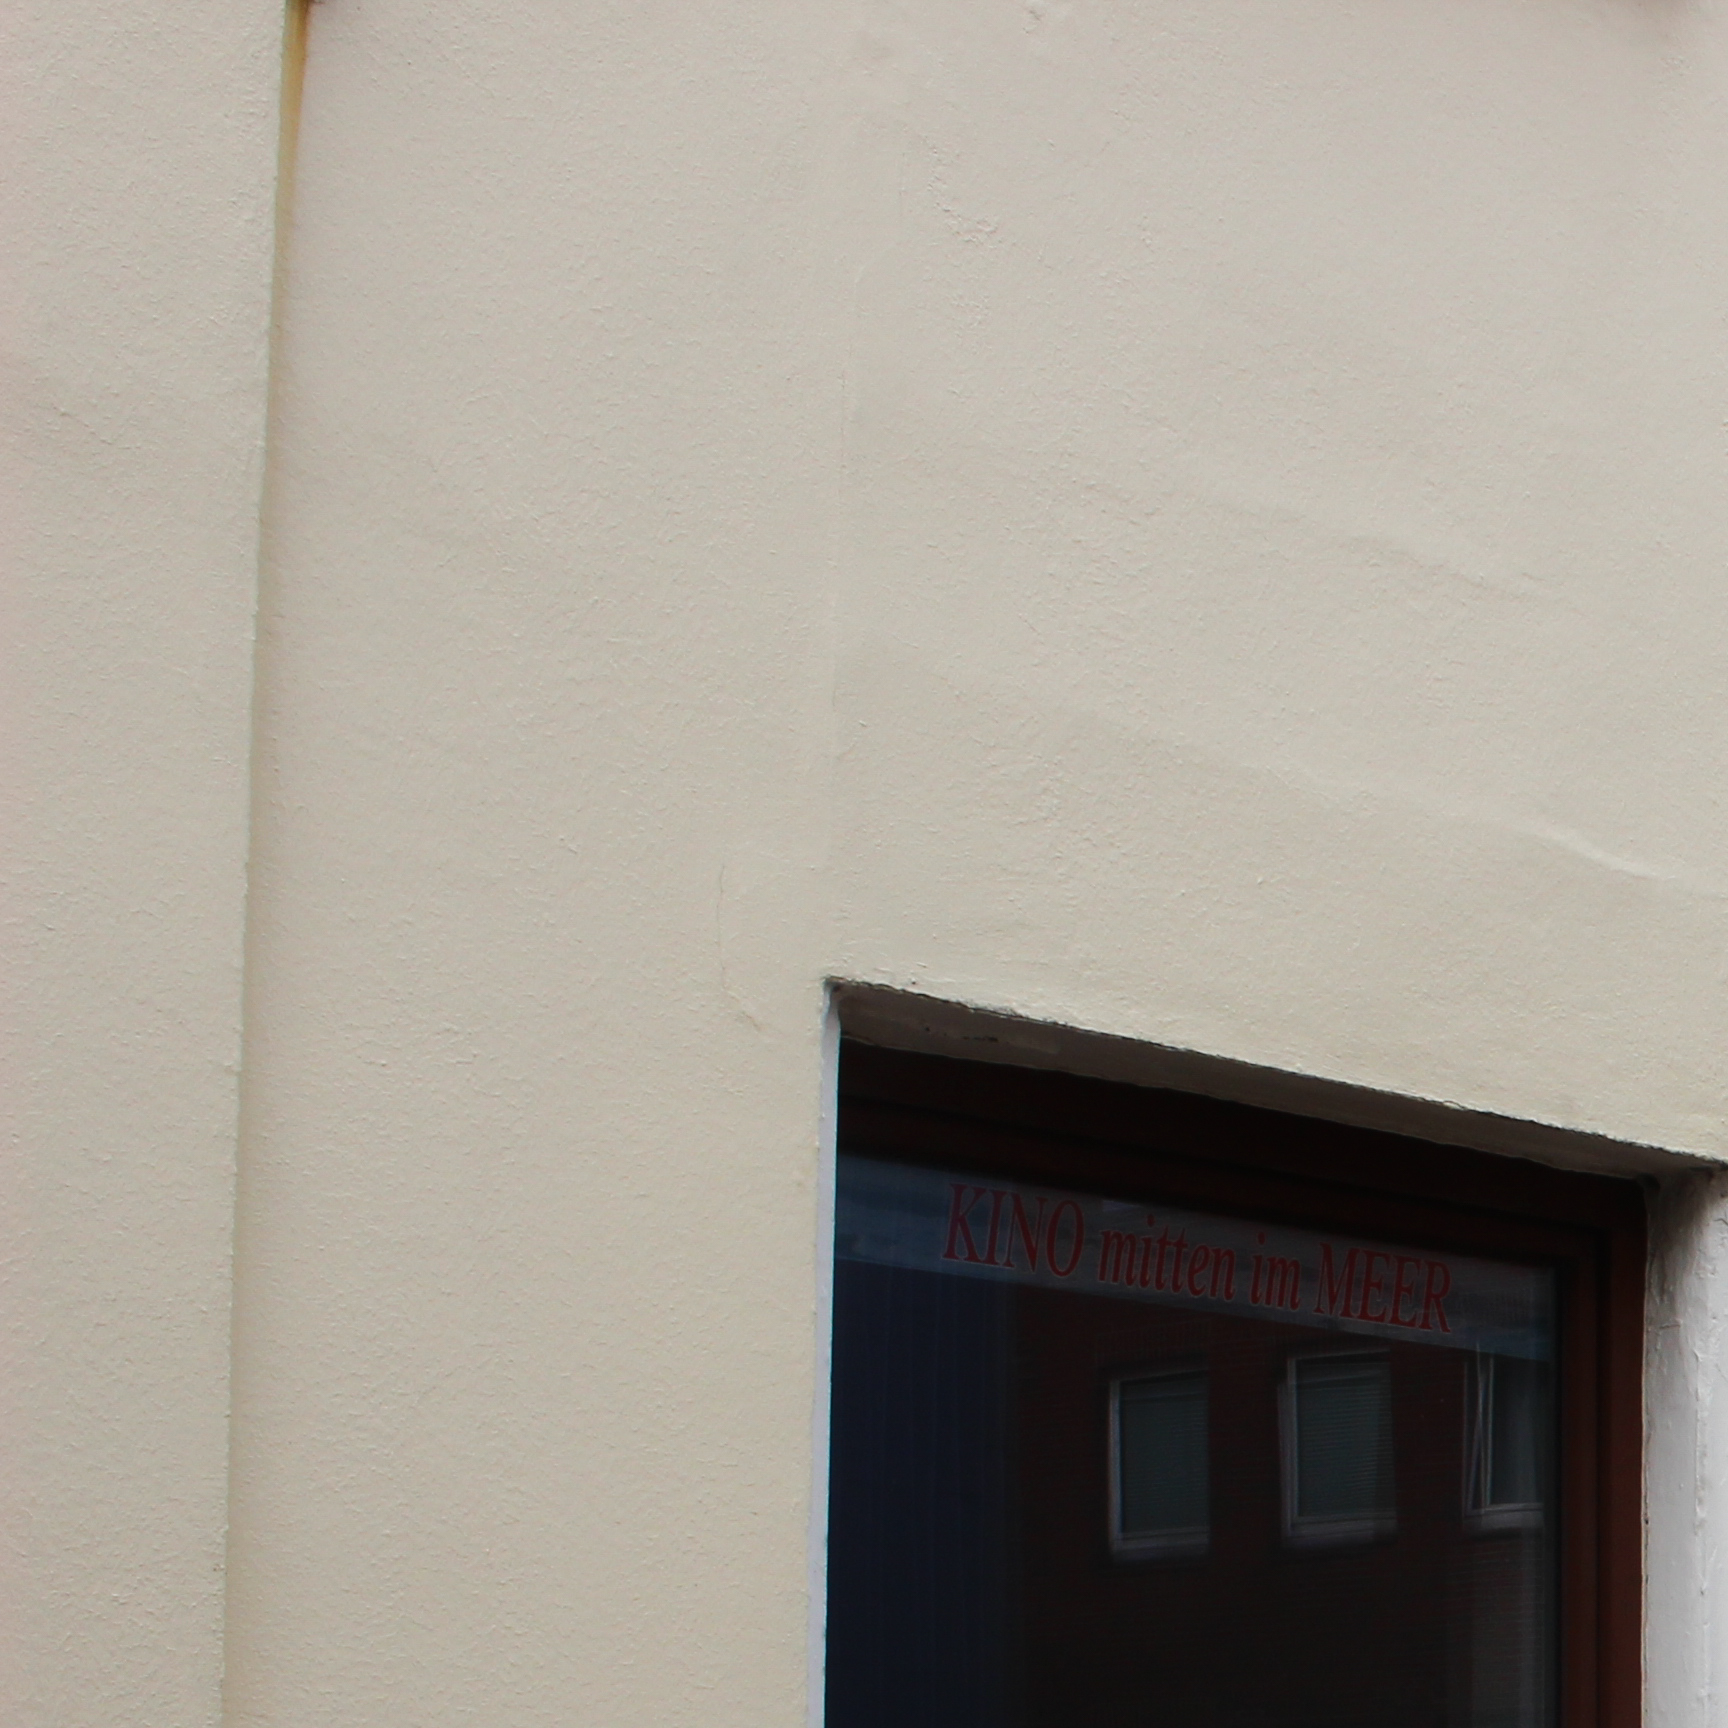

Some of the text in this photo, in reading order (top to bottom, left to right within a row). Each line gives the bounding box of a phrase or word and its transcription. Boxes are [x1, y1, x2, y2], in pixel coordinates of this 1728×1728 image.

[942, 1182, 1452, 1333] KINO mitten im MEER
